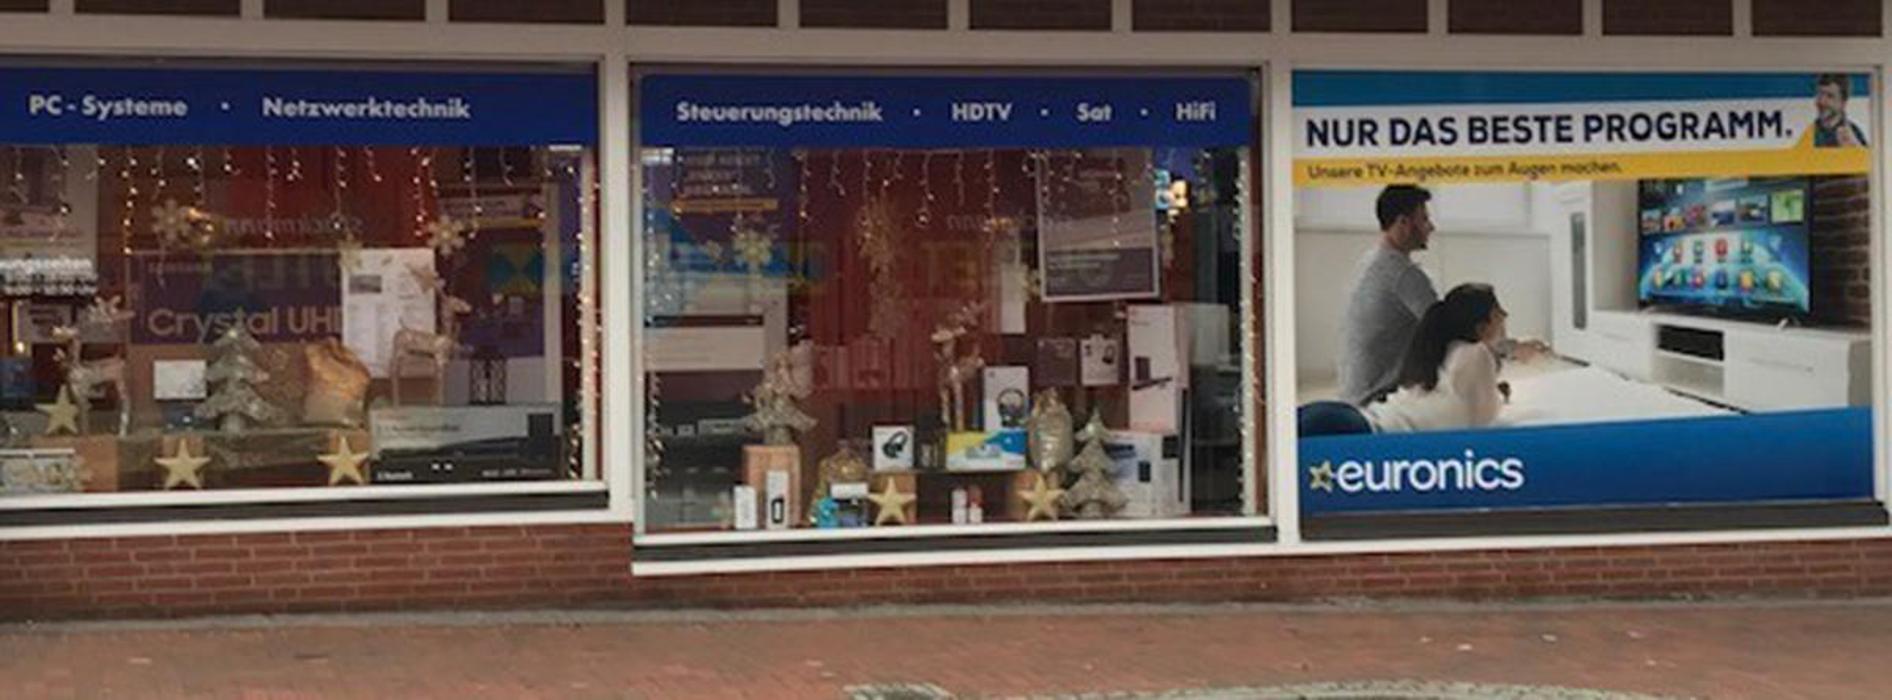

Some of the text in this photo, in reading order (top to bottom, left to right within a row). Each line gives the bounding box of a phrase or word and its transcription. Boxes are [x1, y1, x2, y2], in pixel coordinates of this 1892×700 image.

[262, 98, 471, 120] Netzwerktechnik
[676, 101, 883, 125] Steuerungstechnik
[951, 103, 1013, 121] HDTV
[1077, 103, 1112, 121] Sat
[1175, 102, 1216, 121] HiFi
[1306, 110, 1793, 146] NUR DAS BESTE PROGRAMM.
[1308, 164, 1363, 179] Unsere
[1366, 163, 1470, 180] TV-Angebote
[1474, 164, 1504, 174] zum
[1508, 161, 1557, 179] Augen
[149, 305, 279, 345] Crystal
[1336, 449, 1524, 492] euronics
